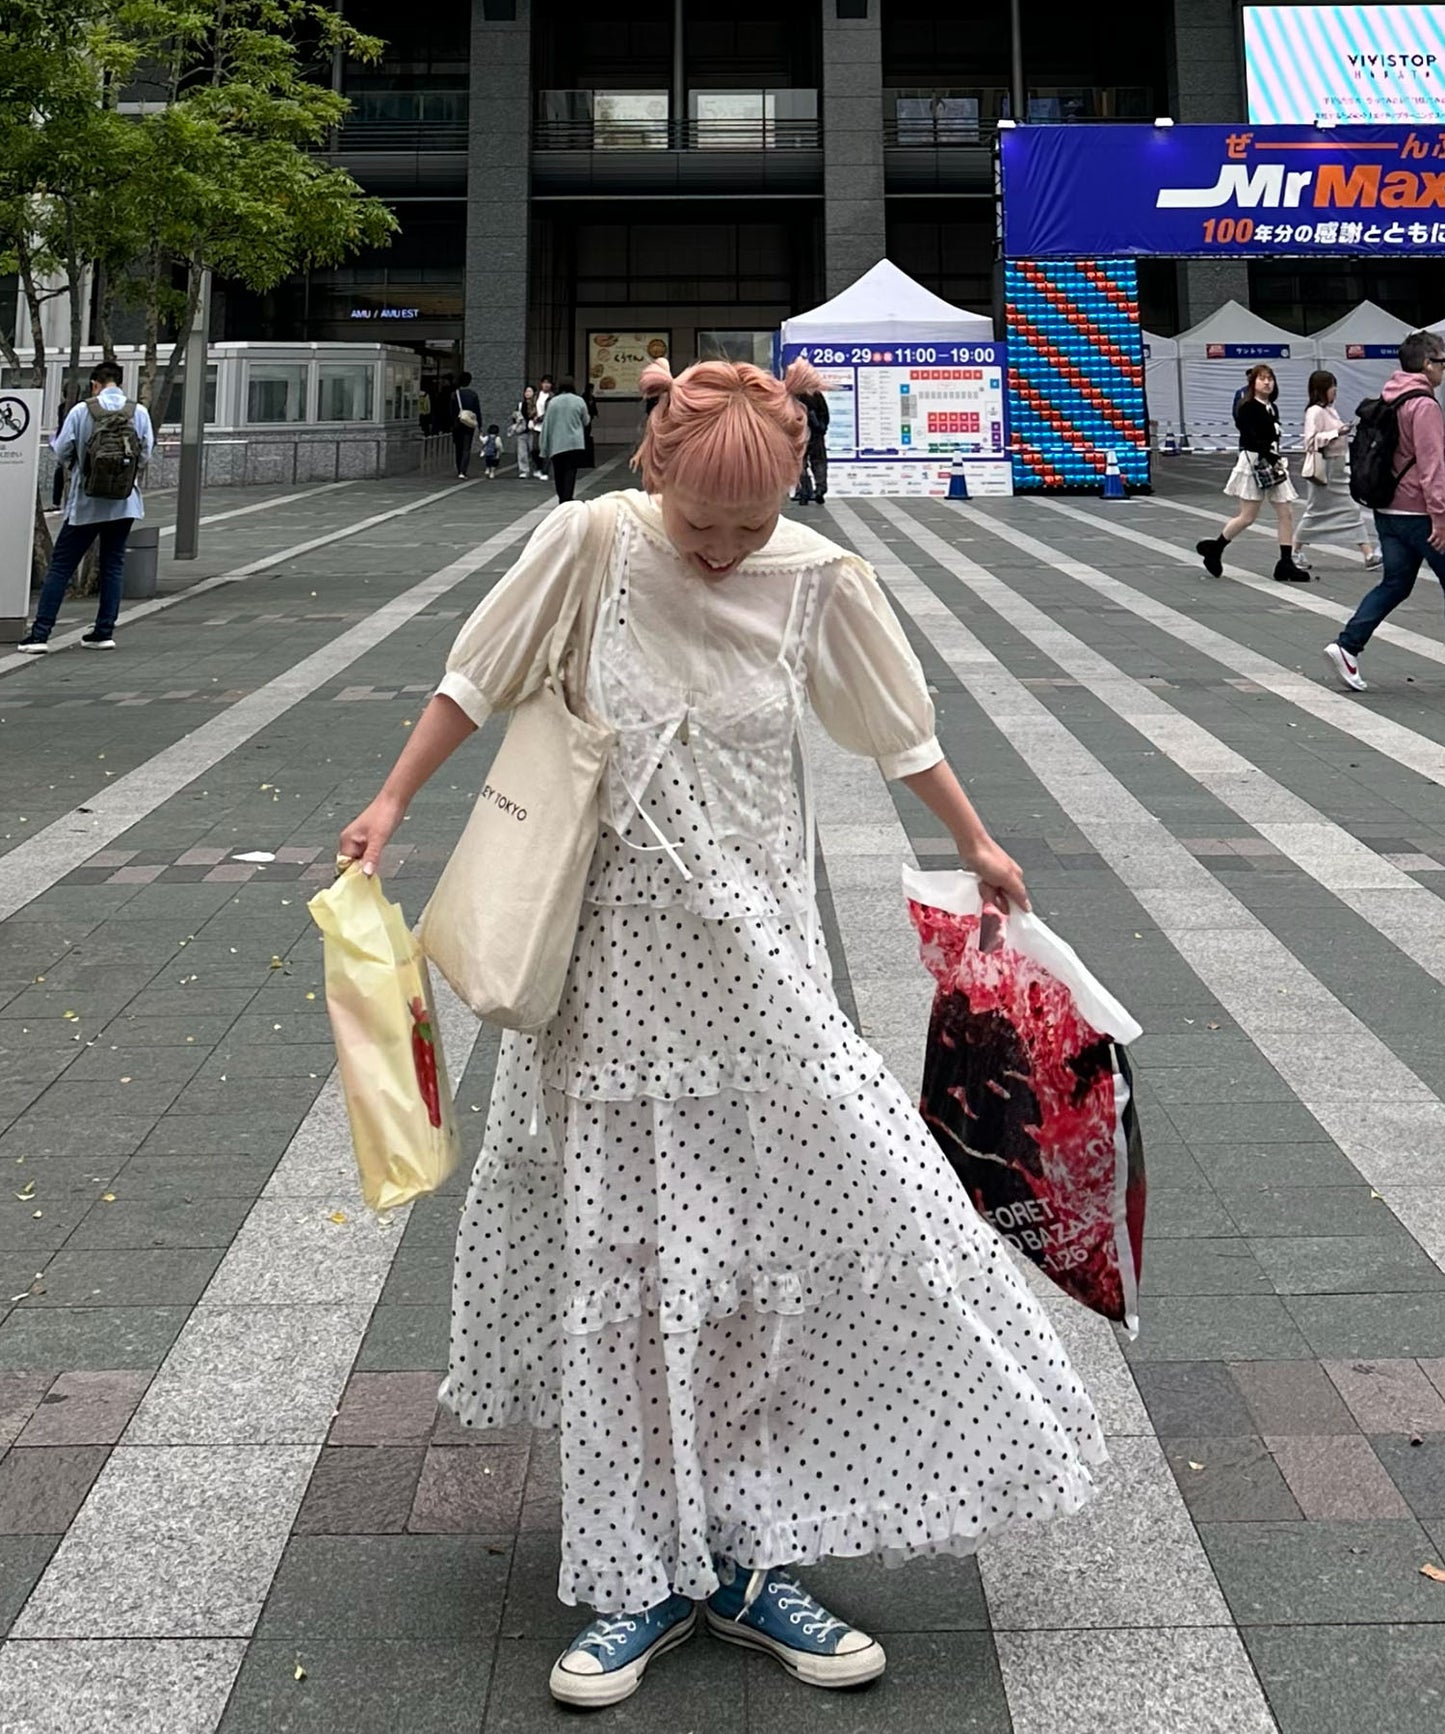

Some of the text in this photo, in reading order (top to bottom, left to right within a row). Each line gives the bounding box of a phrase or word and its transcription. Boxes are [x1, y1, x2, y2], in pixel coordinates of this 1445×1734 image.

[1347, 54, 1437, 67] VIVISTOP
[1156, 164, 1445, 209] MrMax
[1202, 218, 1445, 244] 100年分の感謝とともに
[351, 309, 371, 318] AMU
[494, 793, 527, 820] TOKYO
